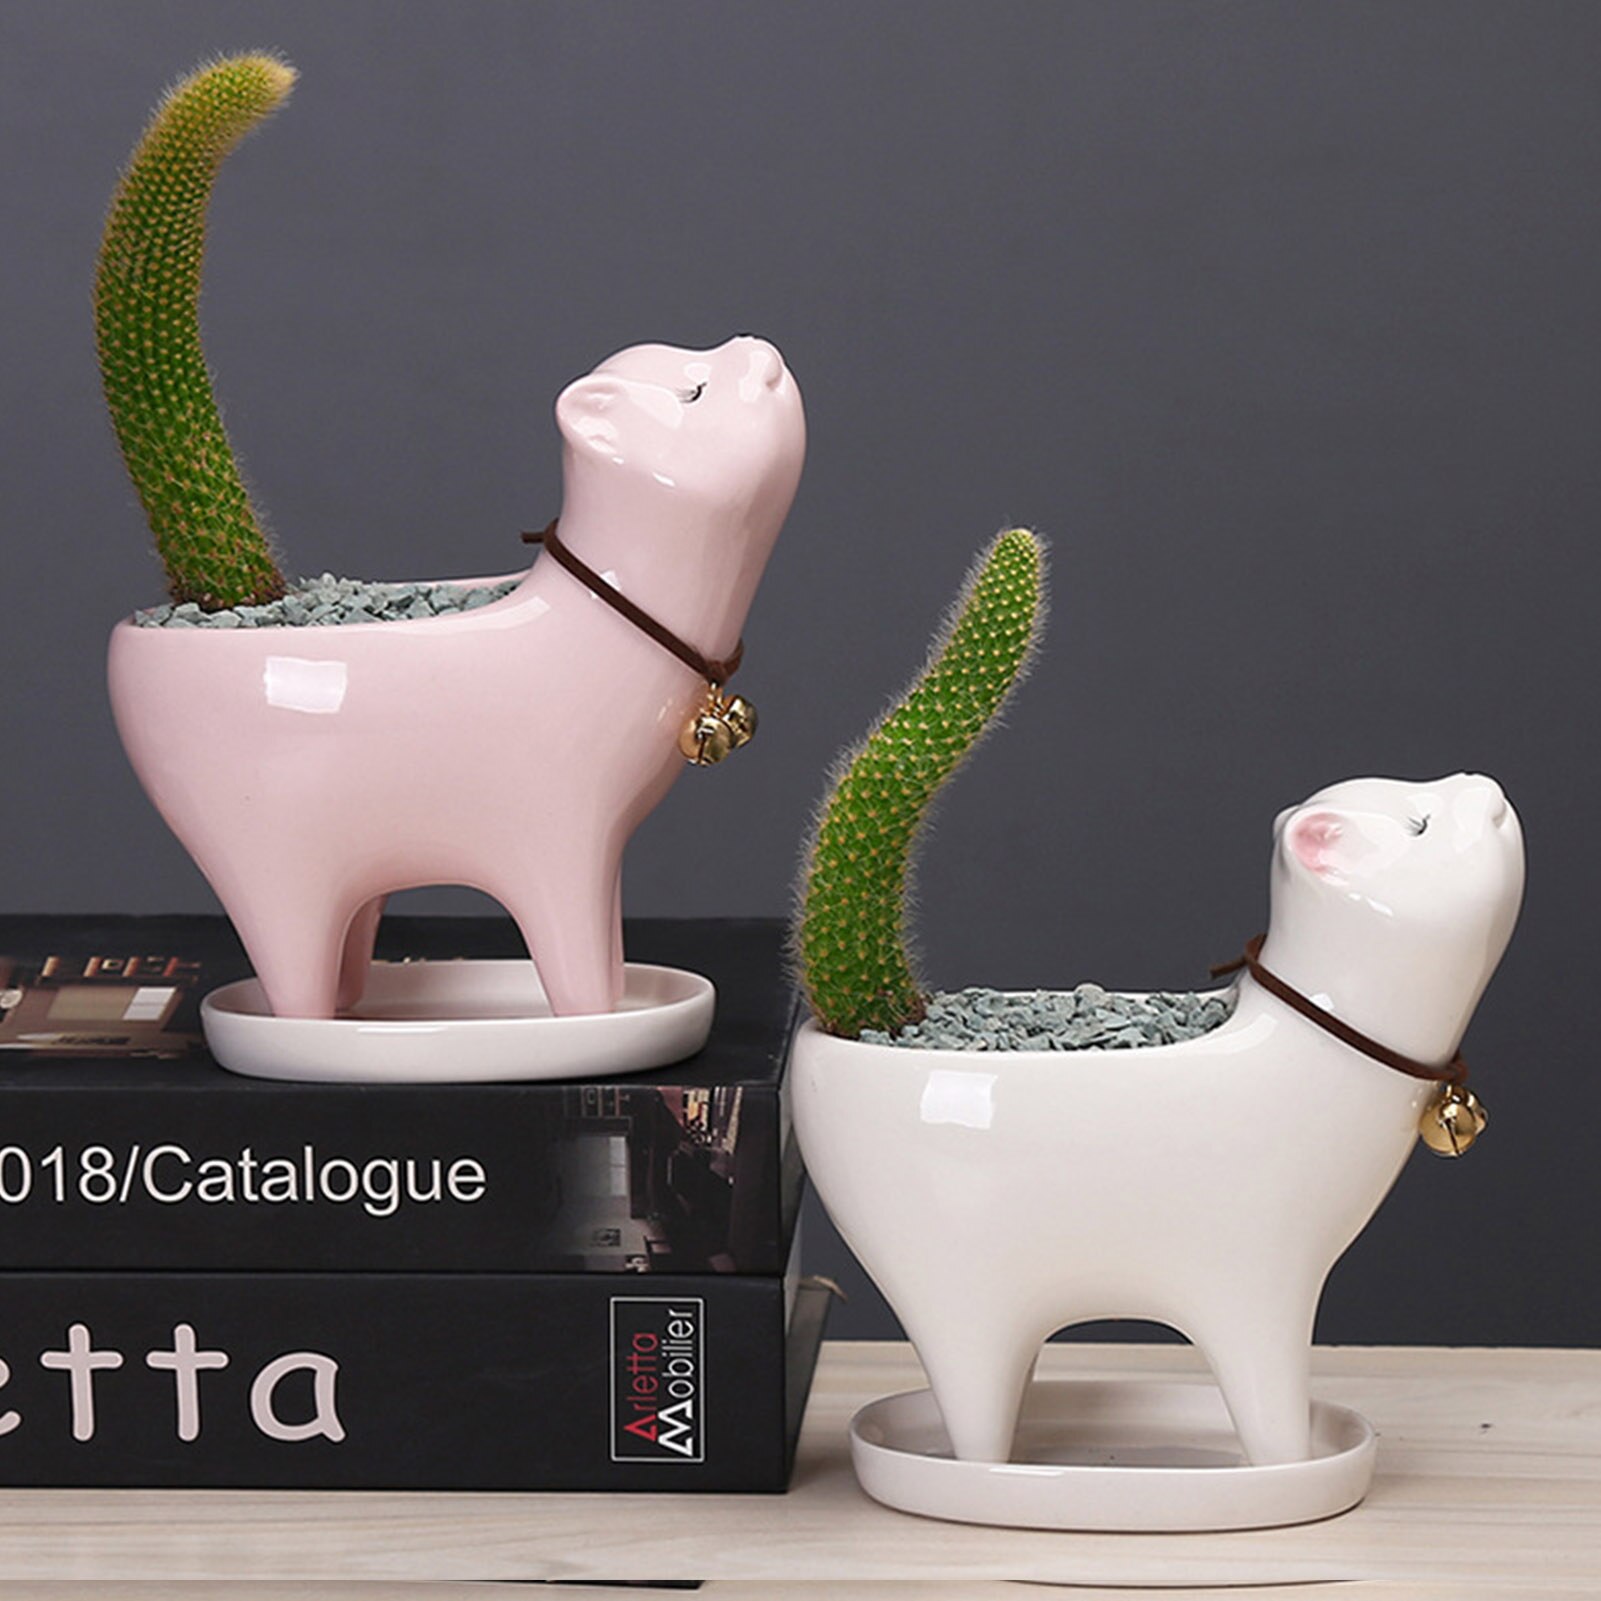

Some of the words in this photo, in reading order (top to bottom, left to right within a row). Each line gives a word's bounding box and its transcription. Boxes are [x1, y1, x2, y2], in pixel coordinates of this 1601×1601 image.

[0, 1145, 486, 1216] 018/Catalogue
[623, 1331, 659, 1442] Arletta
[657, 1308, 695, 1457] Mobilier
